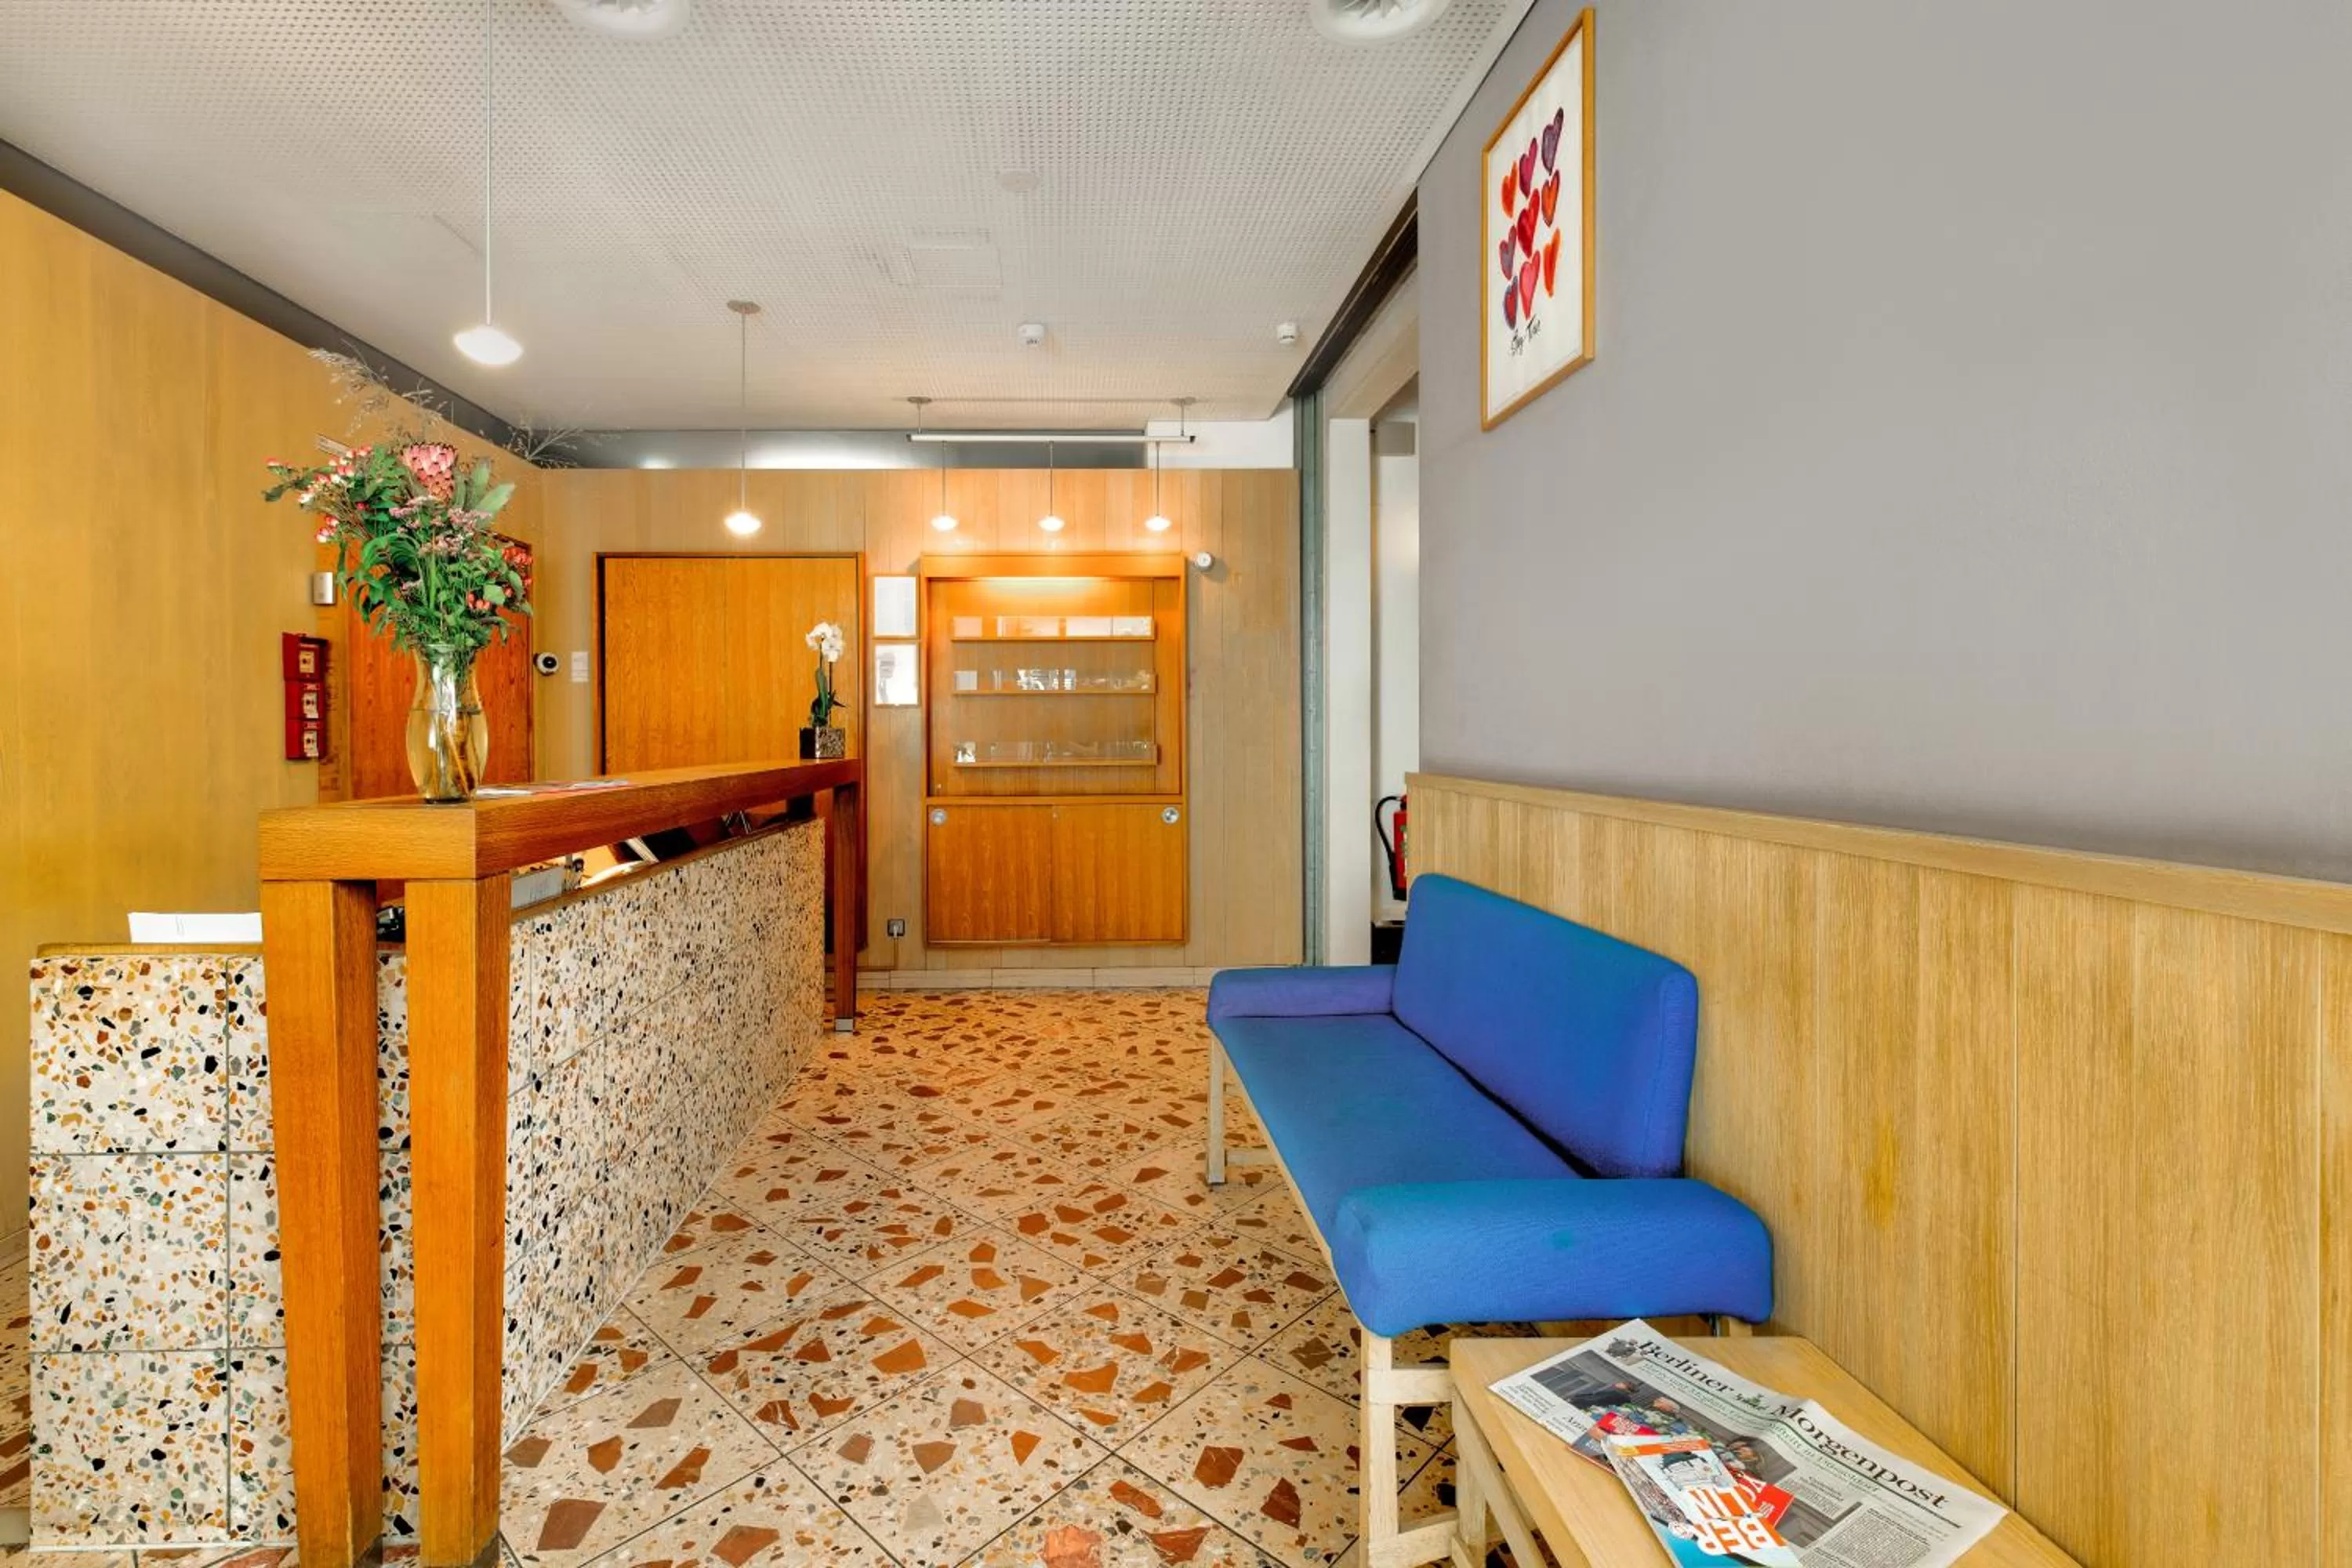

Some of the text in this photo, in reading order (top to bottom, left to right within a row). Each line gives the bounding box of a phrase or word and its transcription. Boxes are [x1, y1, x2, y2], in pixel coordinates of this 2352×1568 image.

[1639, 1341, 1733, 1393] Berliner
[1771, 1403, 1951, 1509] Morgenpost
[1686, 1486, 1759, 1523] LIN
[1691, 1516, 1780, 1555] BER
